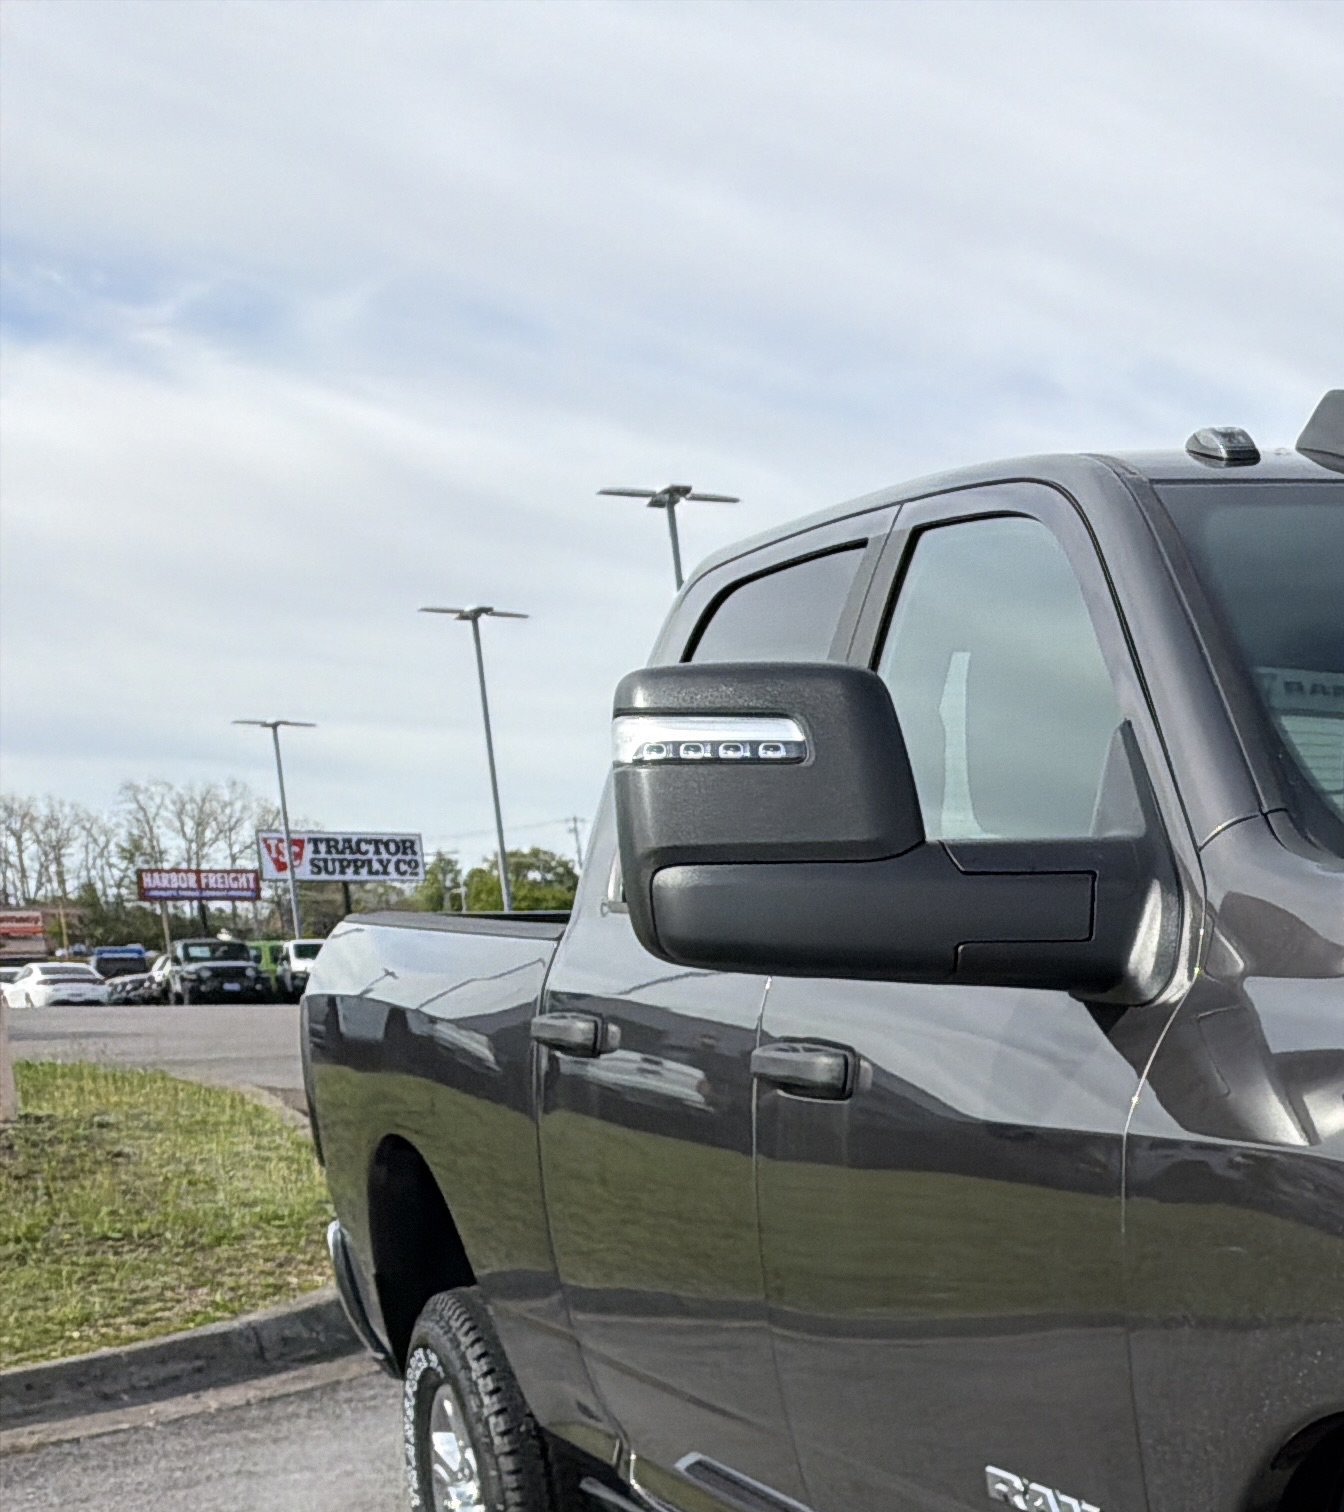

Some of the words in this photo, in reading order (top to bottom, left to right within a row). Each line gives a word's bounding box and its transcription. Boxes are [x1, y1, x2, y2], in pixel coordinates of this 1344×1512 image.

[307, 836, 418, 857] TRACTOR
[310, 857, 394, 876] SUPPLY
[142, 871, 197, 889] HARBOR
[200, 871, 255, 889] FREIGHT
